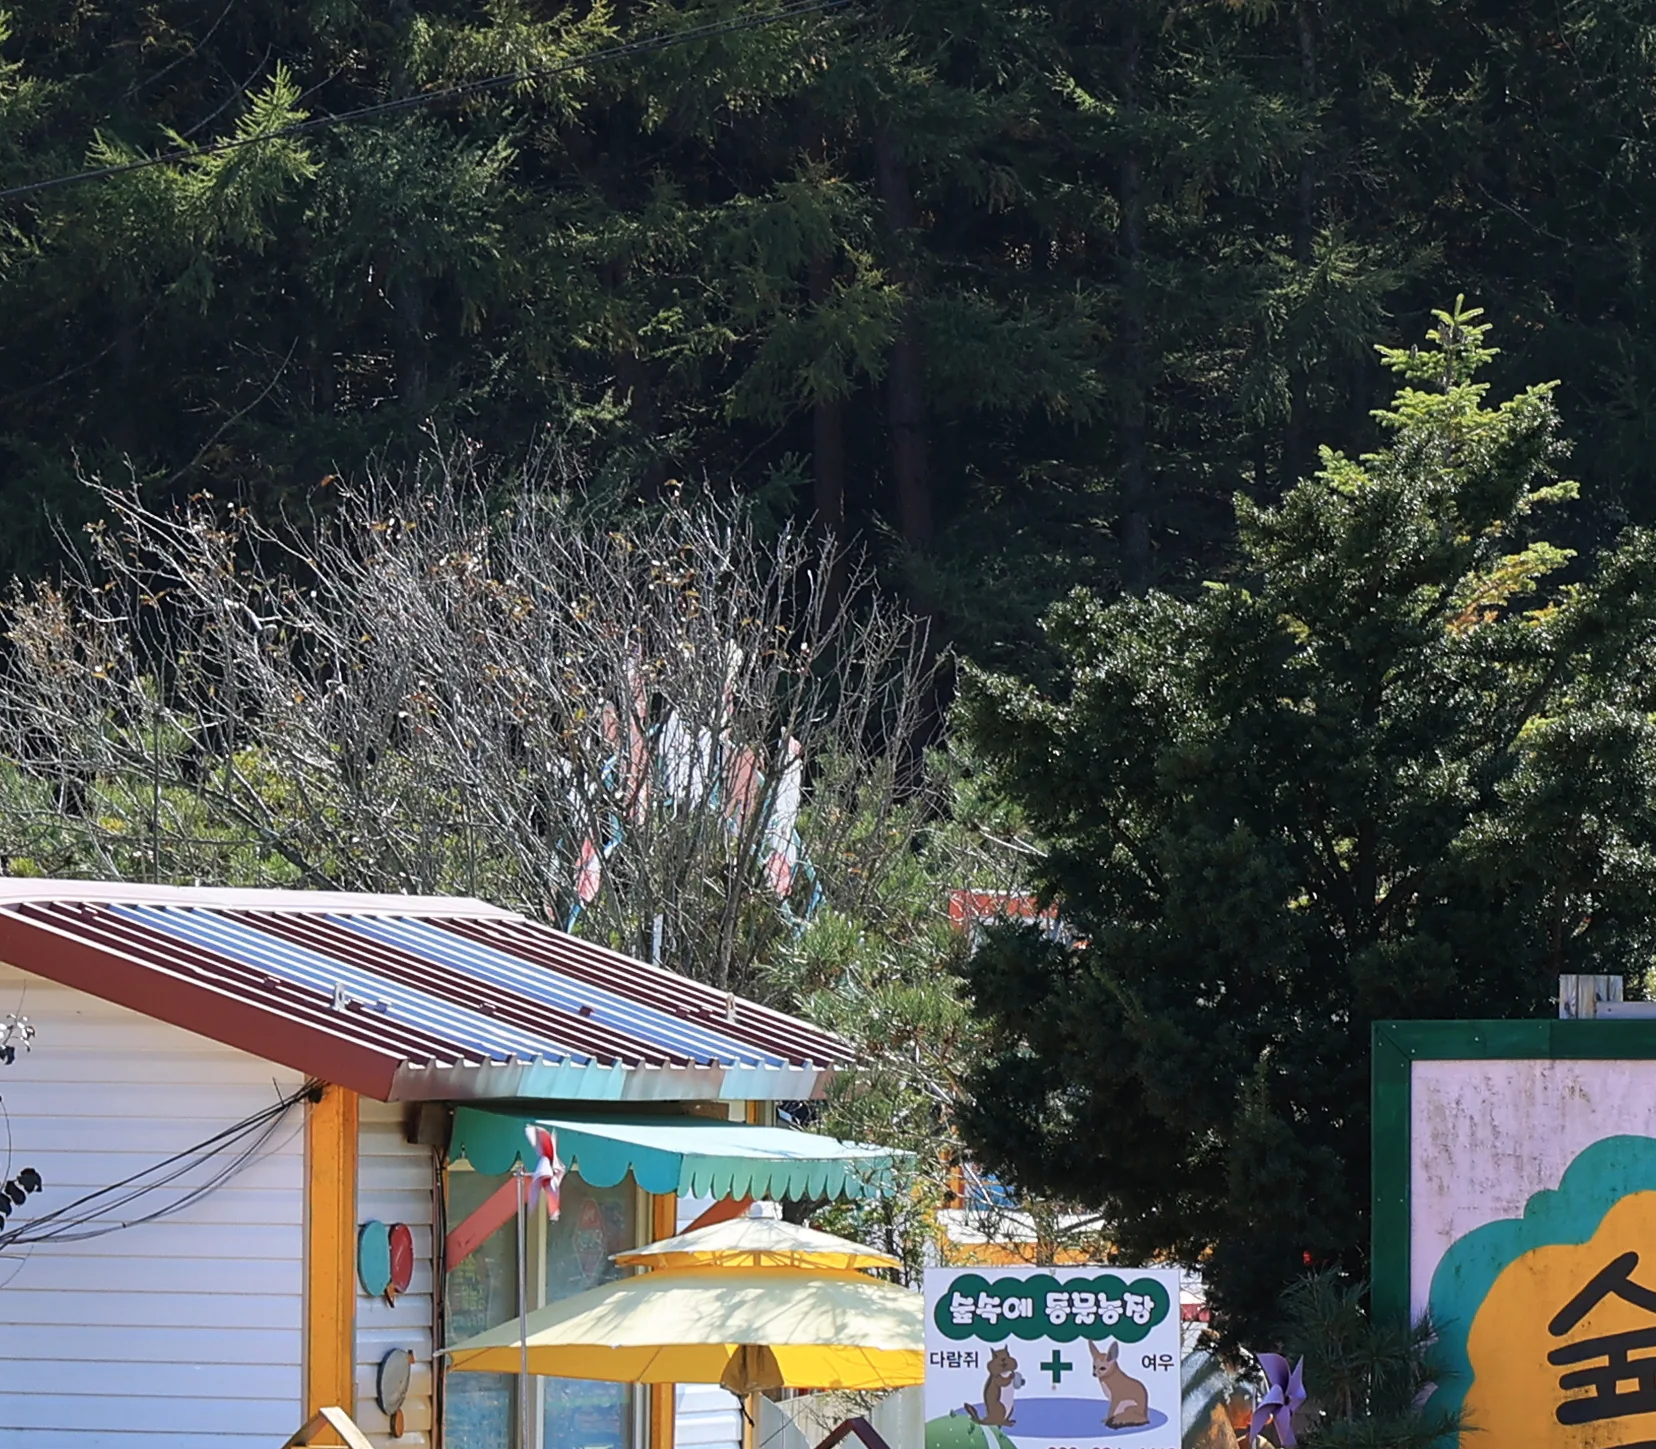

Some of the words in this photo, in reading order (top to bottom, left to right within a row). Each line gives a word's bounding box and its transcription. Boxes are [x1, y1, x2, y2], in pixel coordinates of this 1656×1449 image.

[949, 1291, 1034, 1325] 숲속에
[1044, 1291, 1155, 1325] 동물농장
[930, 1350, 979, 1369] 다람쥐
[1141, 1353, 1175, 1372] 여우
